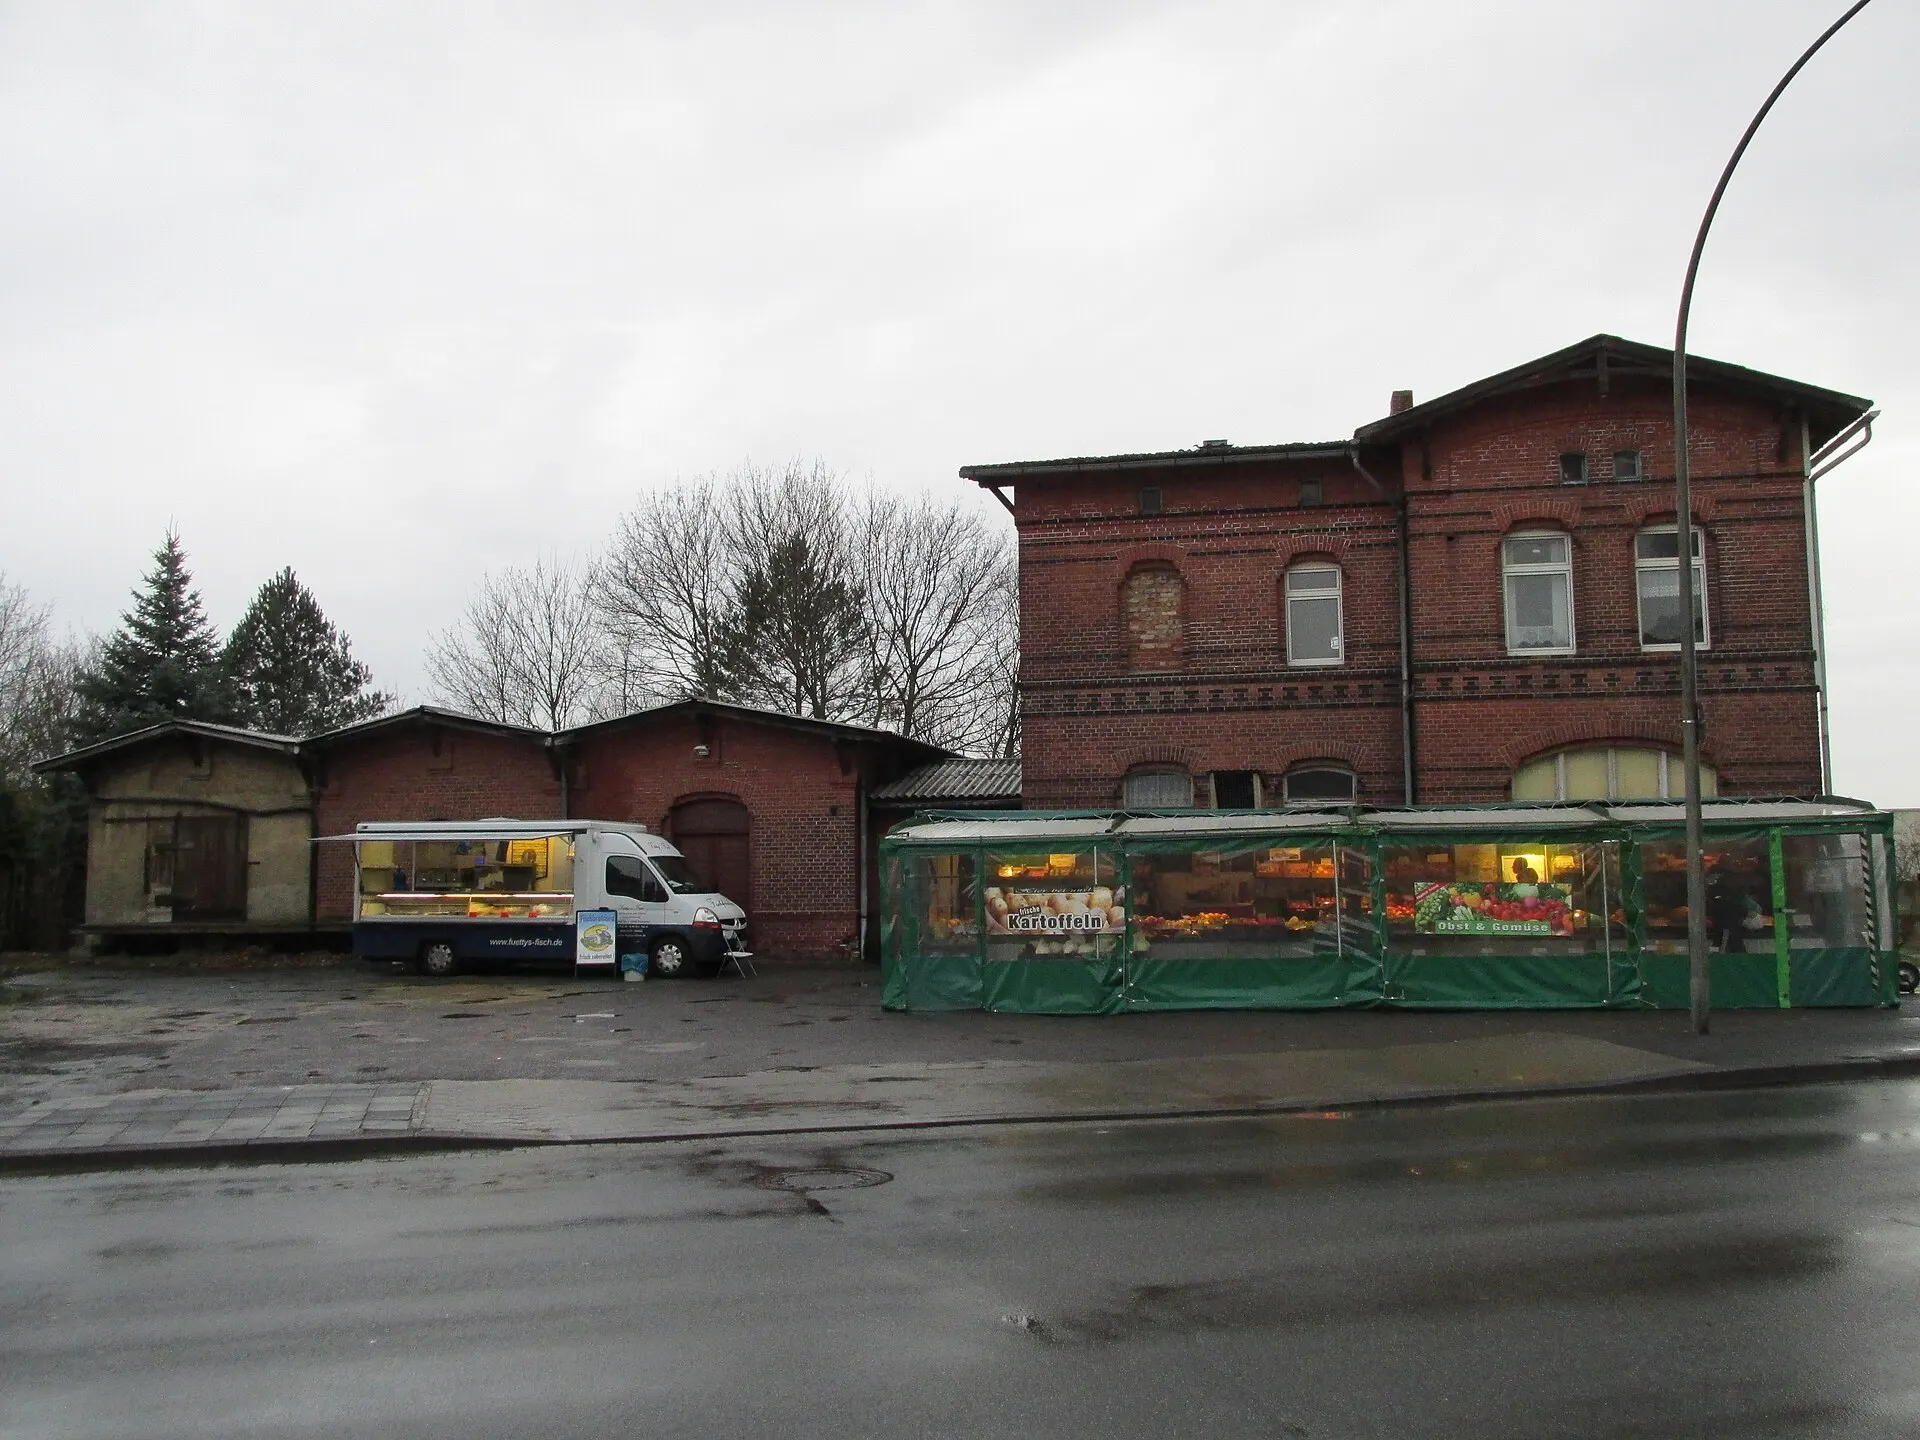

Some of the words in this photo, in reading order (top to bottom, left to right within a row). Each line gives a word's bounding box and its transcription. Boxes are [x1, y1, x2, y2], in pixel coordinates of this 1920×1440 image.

[1019, 906, 1040, 915] frische
[1008, 914, 1101, 929] Kartoffeln
[1438, 922, 1470, 931] Obst
[1475, 922, 1486, 931] &
[1492, 922, 1549, 932] Gemüse
